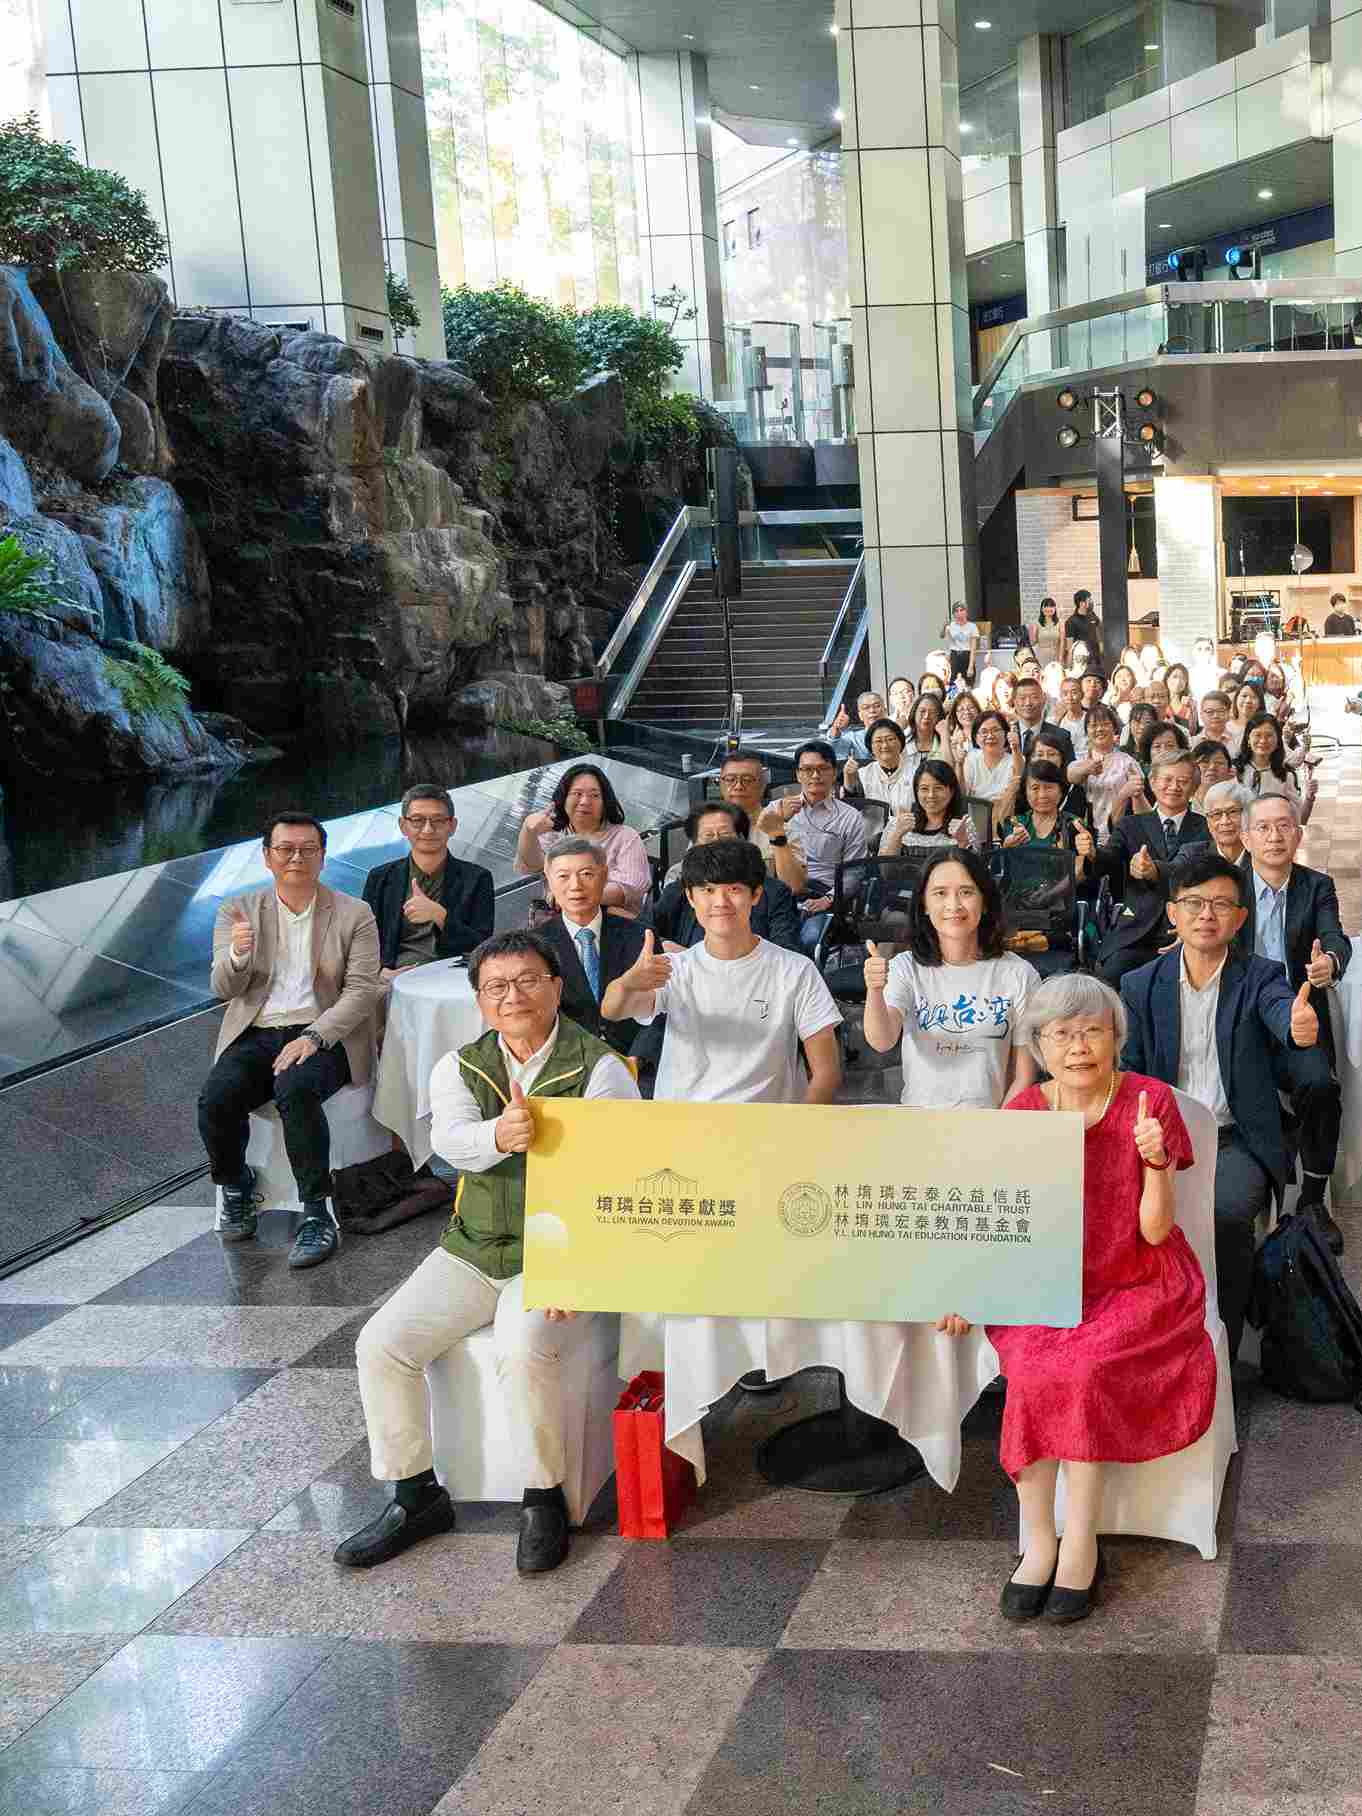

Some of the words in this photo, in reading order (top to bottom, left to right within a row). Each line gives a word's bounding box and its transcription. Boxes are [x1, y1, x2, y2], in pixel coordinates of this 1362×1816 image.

[856, 1200, 873, 1209] LIN
[878, 1200, 907, 1211] HUNG
[911, 1202, 927, 1211] TAI
[930, 1203, 993, 1214] CHARITABLE
[998, 1205, 1031, 1215] TRUST
[612, 1216, 626, 1224] LIN
[628, 1216, 660, 1225] TAIWAN
[661, 1217, 703, 1226] DEVOTION
[704, 1219, 736, 1228] AWARD
[851, 1230, 867, 1239] LIN
[867, 1231, 896, 1239] HUNG
[898, 1231, 913, 1240] TAI
[914, 1231, 968, 1241] EDUCATION
[970, 1233, 1032, 1244] FOUNDATION
